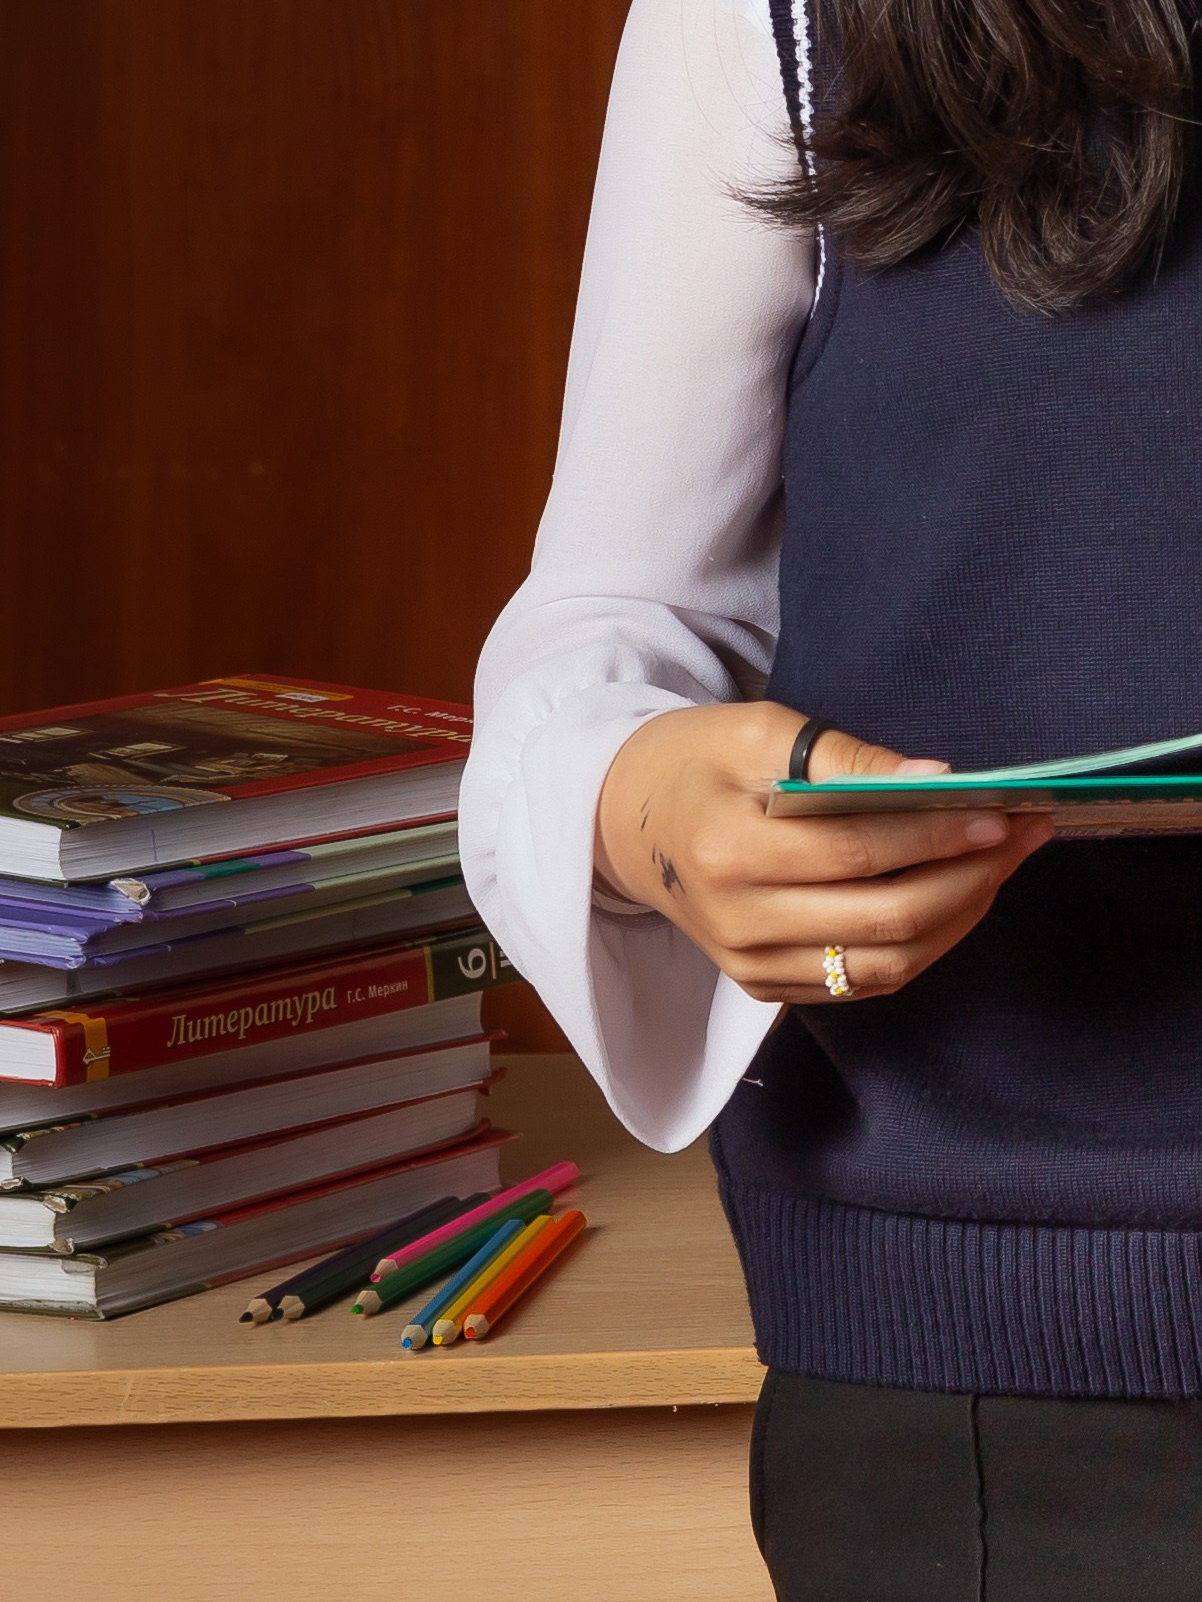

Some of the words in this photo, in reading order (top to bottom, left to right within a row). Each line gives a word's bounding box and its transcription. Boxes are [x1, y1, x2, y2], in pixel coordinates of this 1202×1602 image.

[154, 688, 473, 742] Литература
[457, 948, 487, 979] 6
[167, 987, 337, 1047] Литература
[347, 988, 366, 1004] Г.С.
[368, 980, 409, 998] Меркин
